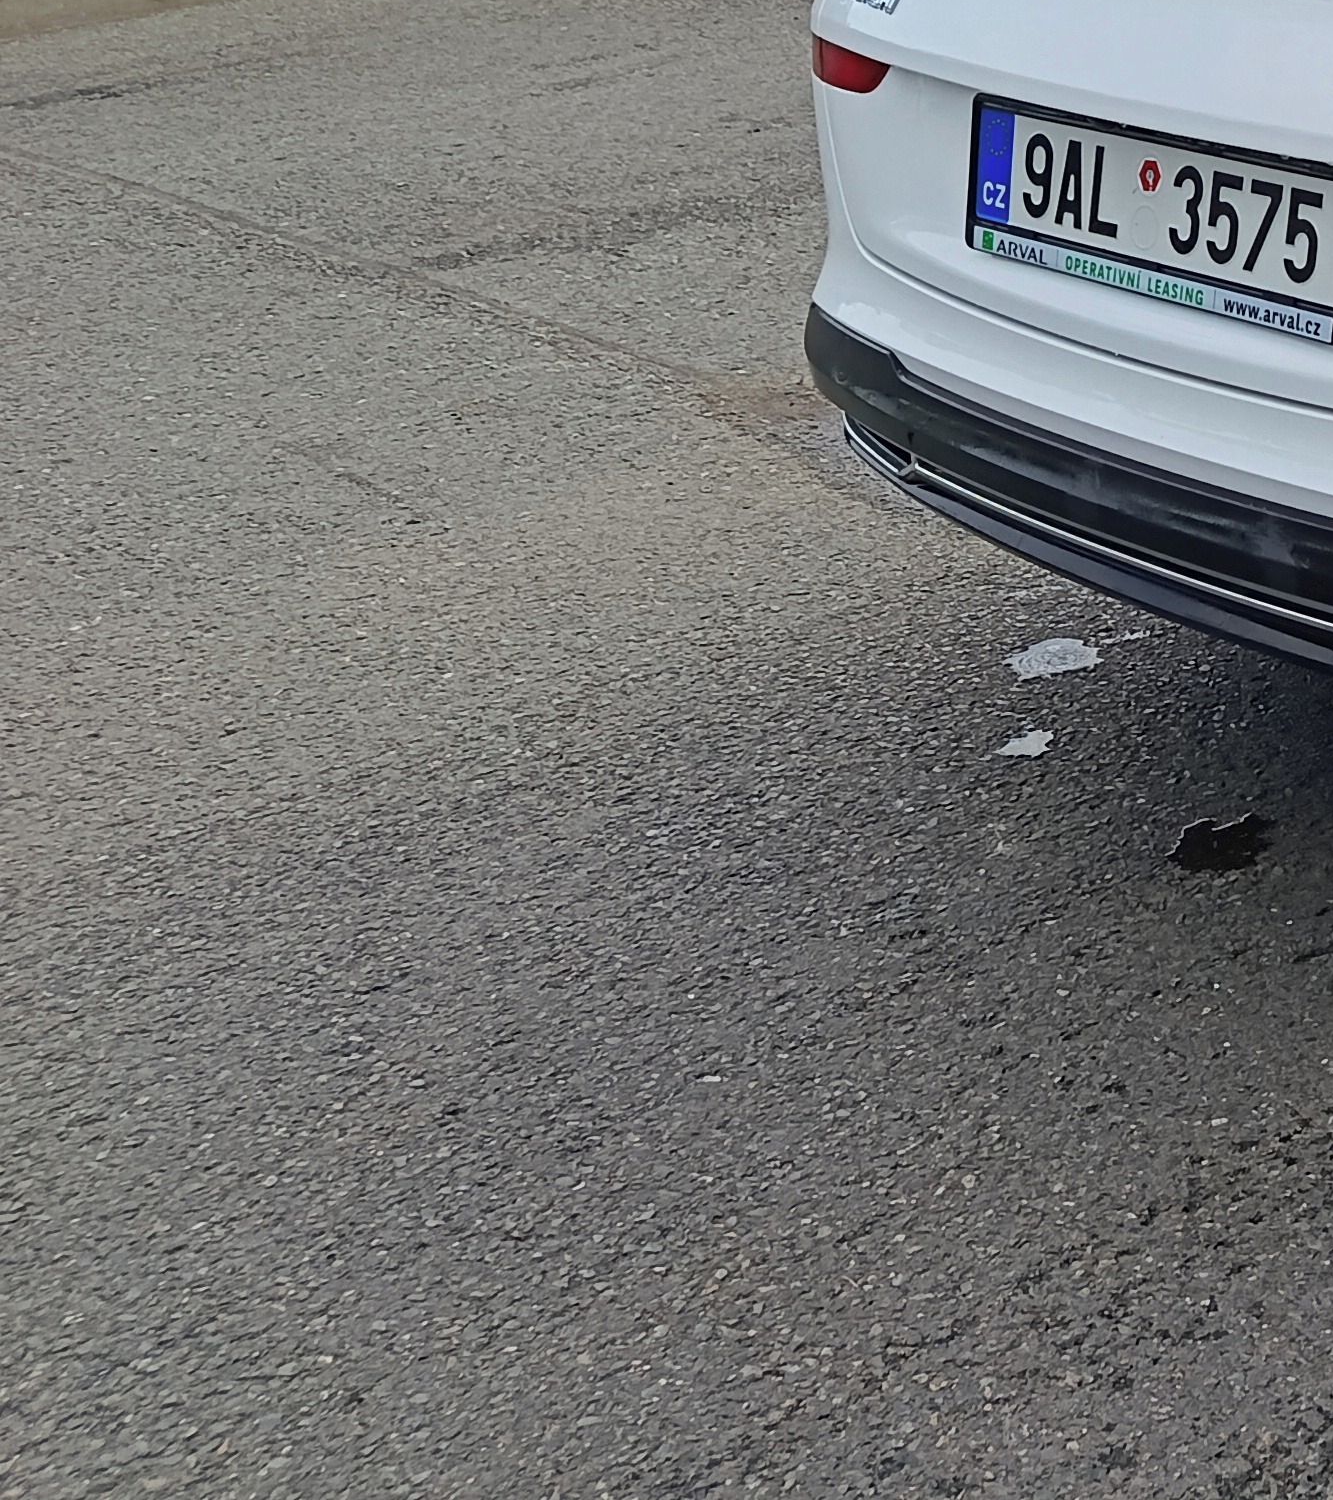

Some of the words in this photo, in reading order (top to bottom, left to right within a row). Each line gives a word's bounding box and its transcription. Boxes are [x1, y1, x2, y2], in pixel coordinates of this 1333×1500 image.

[982, 181, 1006, 209] CZ
[1022, 132, 1120, 239] 9AL
[1168, 164, 1324, 284] 3575
[996, 239, 1049, 266] ARVAL
[1065, 254, 1142, 290] OPERATIVNÍ
[1147, 279, 1205, 307] LEASING
[1223, 297, 1322, 337] www.arval.cz
